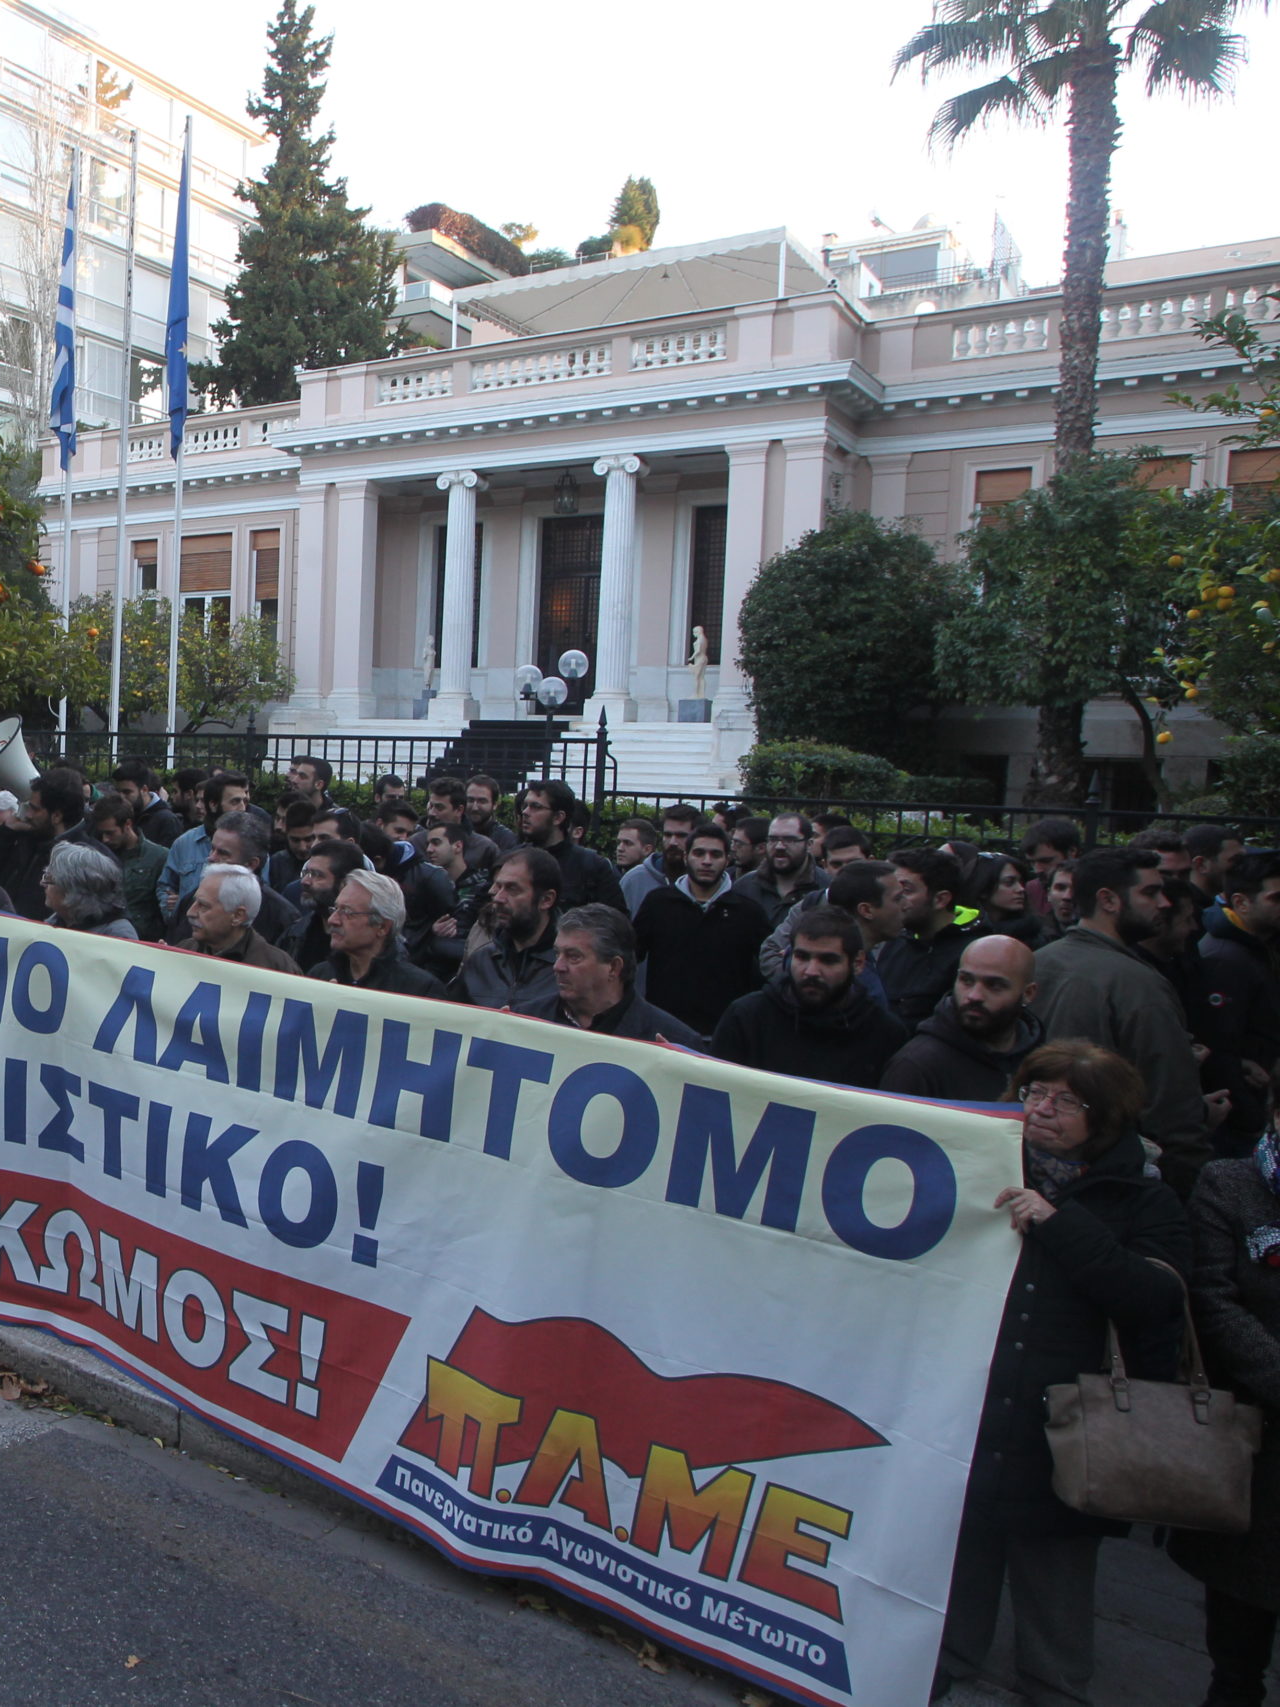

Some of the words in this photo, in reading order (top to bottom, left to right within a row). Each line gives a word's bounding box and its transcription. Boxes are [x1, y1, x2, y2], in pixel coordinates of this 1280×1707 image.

[93, 966, 958, 1260] ΛΑΙΜΗΤΟΜΟ
[394, 1465, 533, 1542] Πανεργατικό
[541, 1524, 691, 1611] Αγωνιστικό
[701, 1593, 827, 1667] Μέτωπο
